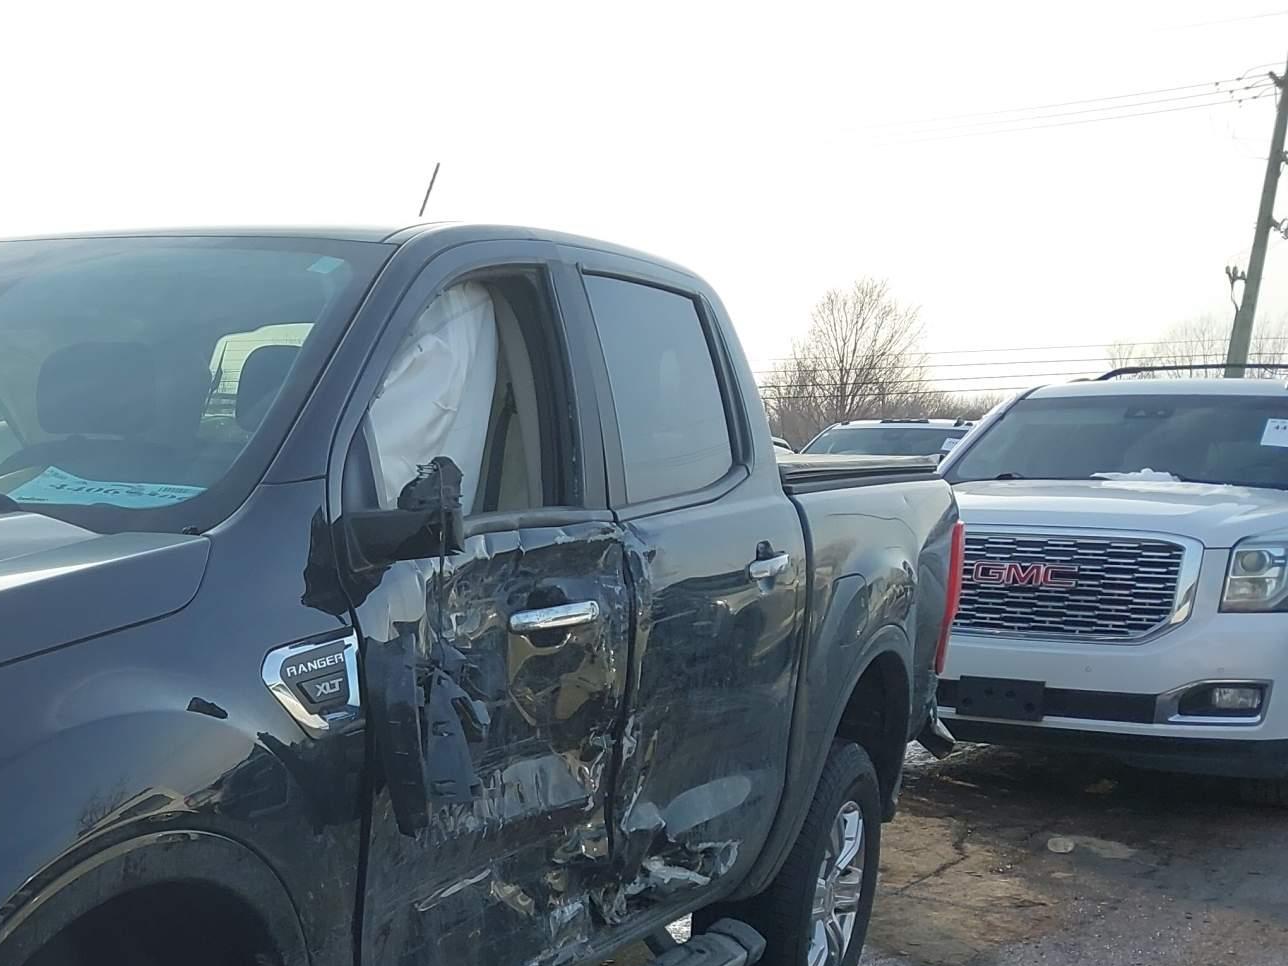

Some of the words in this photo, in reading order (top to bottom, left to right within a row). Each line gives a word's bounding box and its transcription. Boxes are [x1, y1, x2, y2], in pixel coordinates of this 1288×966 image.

[972, 560, 1079, 588] GMC
[286, 652, 344, 678] RANGER
[315, 678, 344, 697] XLT
